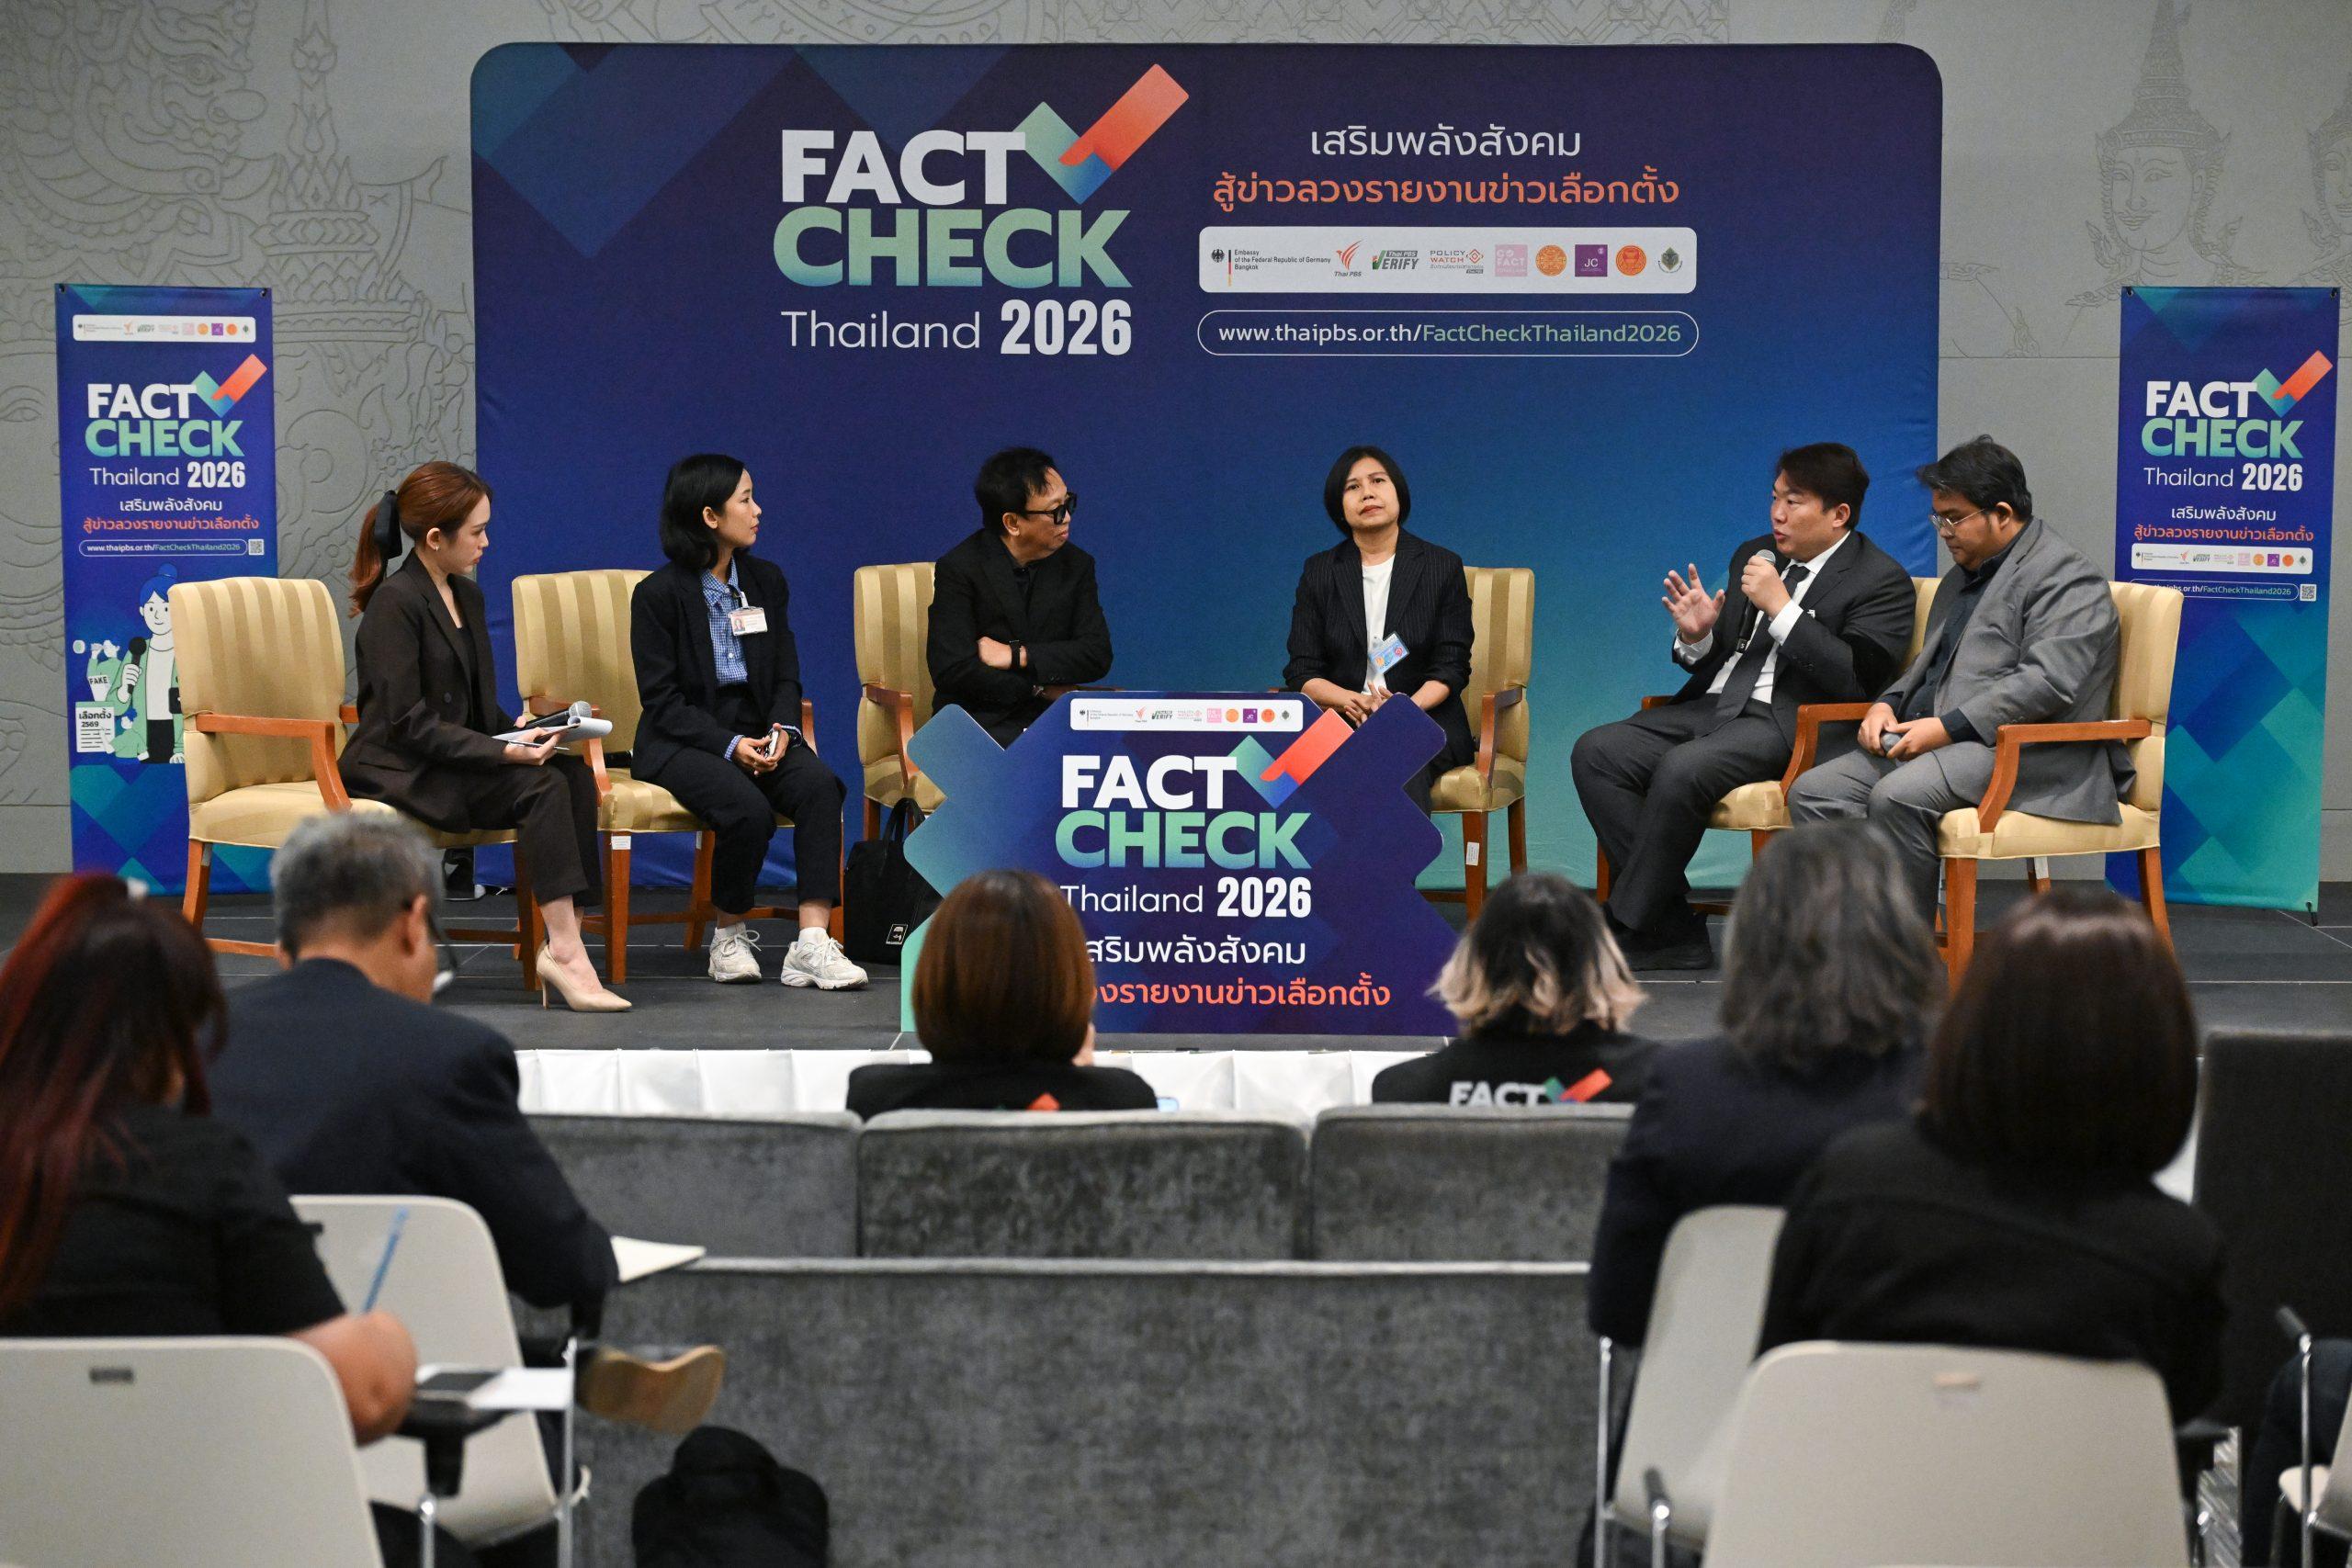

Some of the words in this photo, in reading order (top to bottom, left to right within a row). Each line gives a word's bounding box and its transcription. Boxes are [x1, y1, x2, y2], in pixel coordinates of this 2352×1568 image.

[1311, 123, 1581, 157] เสริมพลังสังคม
[782, 130, 1026, 205] FACT
[1213, 165, 1680, 212] สู้ข่าวลวงรายงานข่าวเลือกตั้ง
[774, 206, 1133, 288] CHECK
[1584, 258, 1599, 267] JC
[781, 310, 979, 349] Thailand
[1001, 299, 1132, 355] 2026
[1218, 323, 1681, 346] www.thaipbs.or.th/FactCheckThailand2026
[87, 383, 197, 419] FACT
[2146, 380, 2257, 418] FACT
[85, 419, 245, 457] CHECK
[2142, 418, 2304, 458] CHECK
[89, 467, 180, 486] Thailand
[187, 461, 246, 488] 2026
[2143, 467, 2233, 488] Thailand
[2242, 463, 2302, 491] 2026
[119, 498, 223, 512] เสริมพลังสังคม
[2171, 506, 2277, 522] เสริมพลังสังคม
[83, 513, 260, 534] สู้ข่าวลวงรายงานข่าวเลือกตั้ง
[2133, 524, 2314, 542] สู้ข่าวลวงรายงานข่าวเลือกตั้ง
[86, 543, 241, 553] www.thaipbs.or.th/FactCheckThailand2026
[89, 676, 108, 684] FAKE
[1062, 754, 1237, 809] FACT
[1055, 810, 1312, 869] CHECK
[1060, 885, 1204, 912] Thailand
[1216, 876, 1312, 918] 2026
[1085, 933, 1306, 964] สริมพลังสังคม
[1094, 972, 1391, 1007] งรายงานข่าวเลือกตั้ง
[1449, 1080, 1548, 1107] FACT
